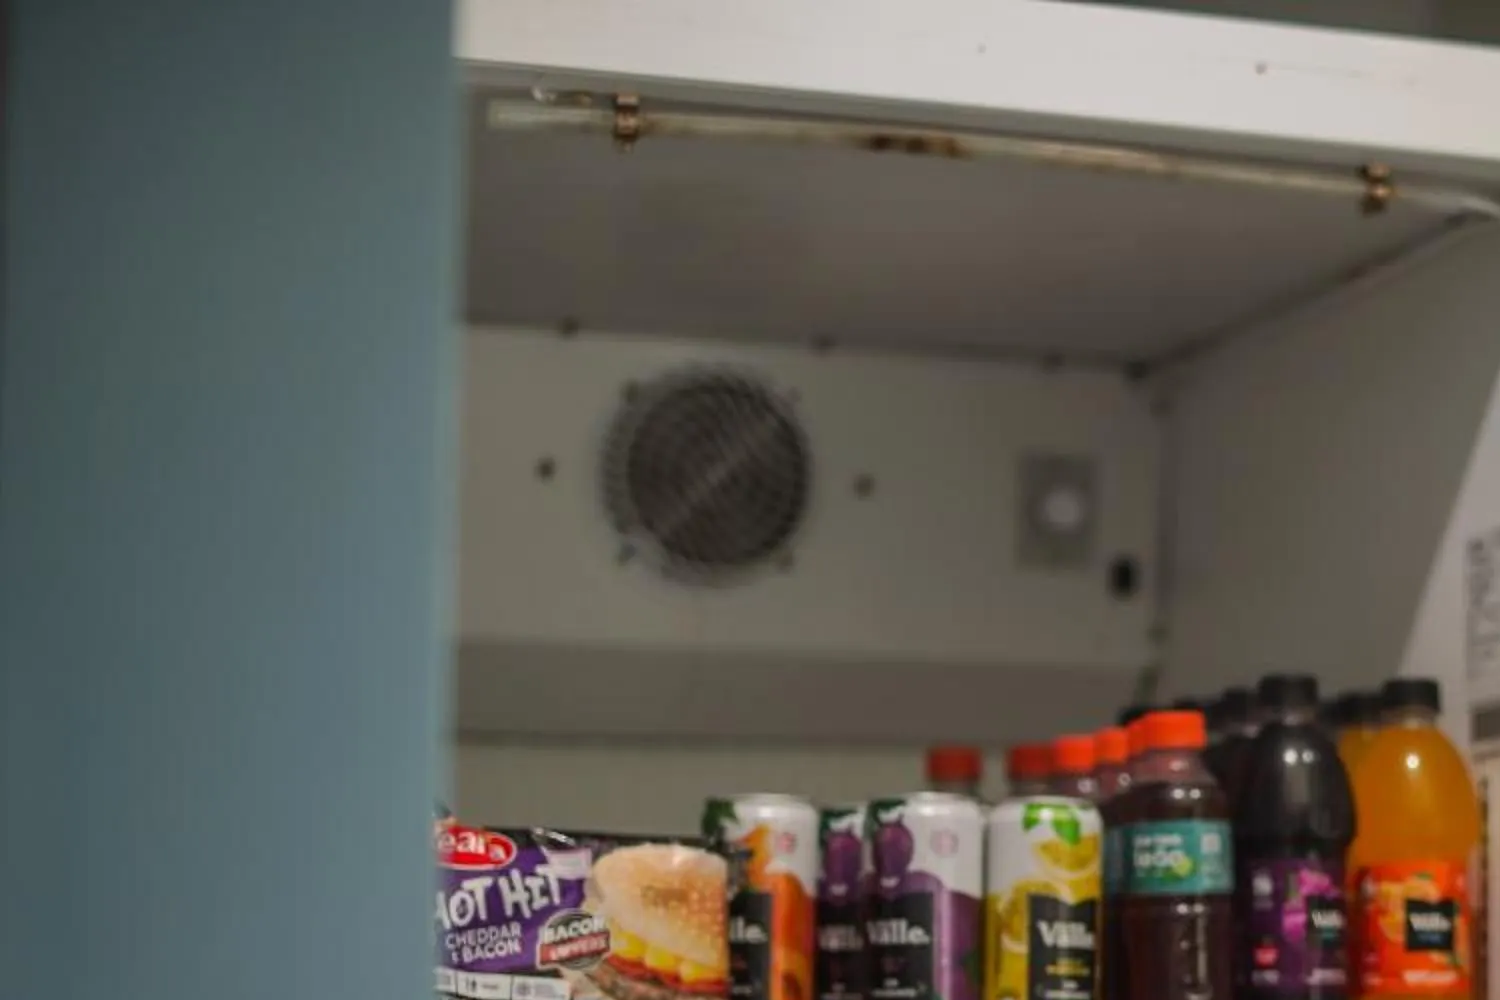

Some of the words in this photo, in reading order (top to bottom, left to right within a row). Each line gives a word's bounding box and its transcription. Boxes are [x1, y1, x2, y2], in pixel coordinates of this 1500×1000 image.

[498, 864, 560, 918] HIT
[446, 922, 521, 949] CHEDDAR
[462, 939, 521, 962] BACON
